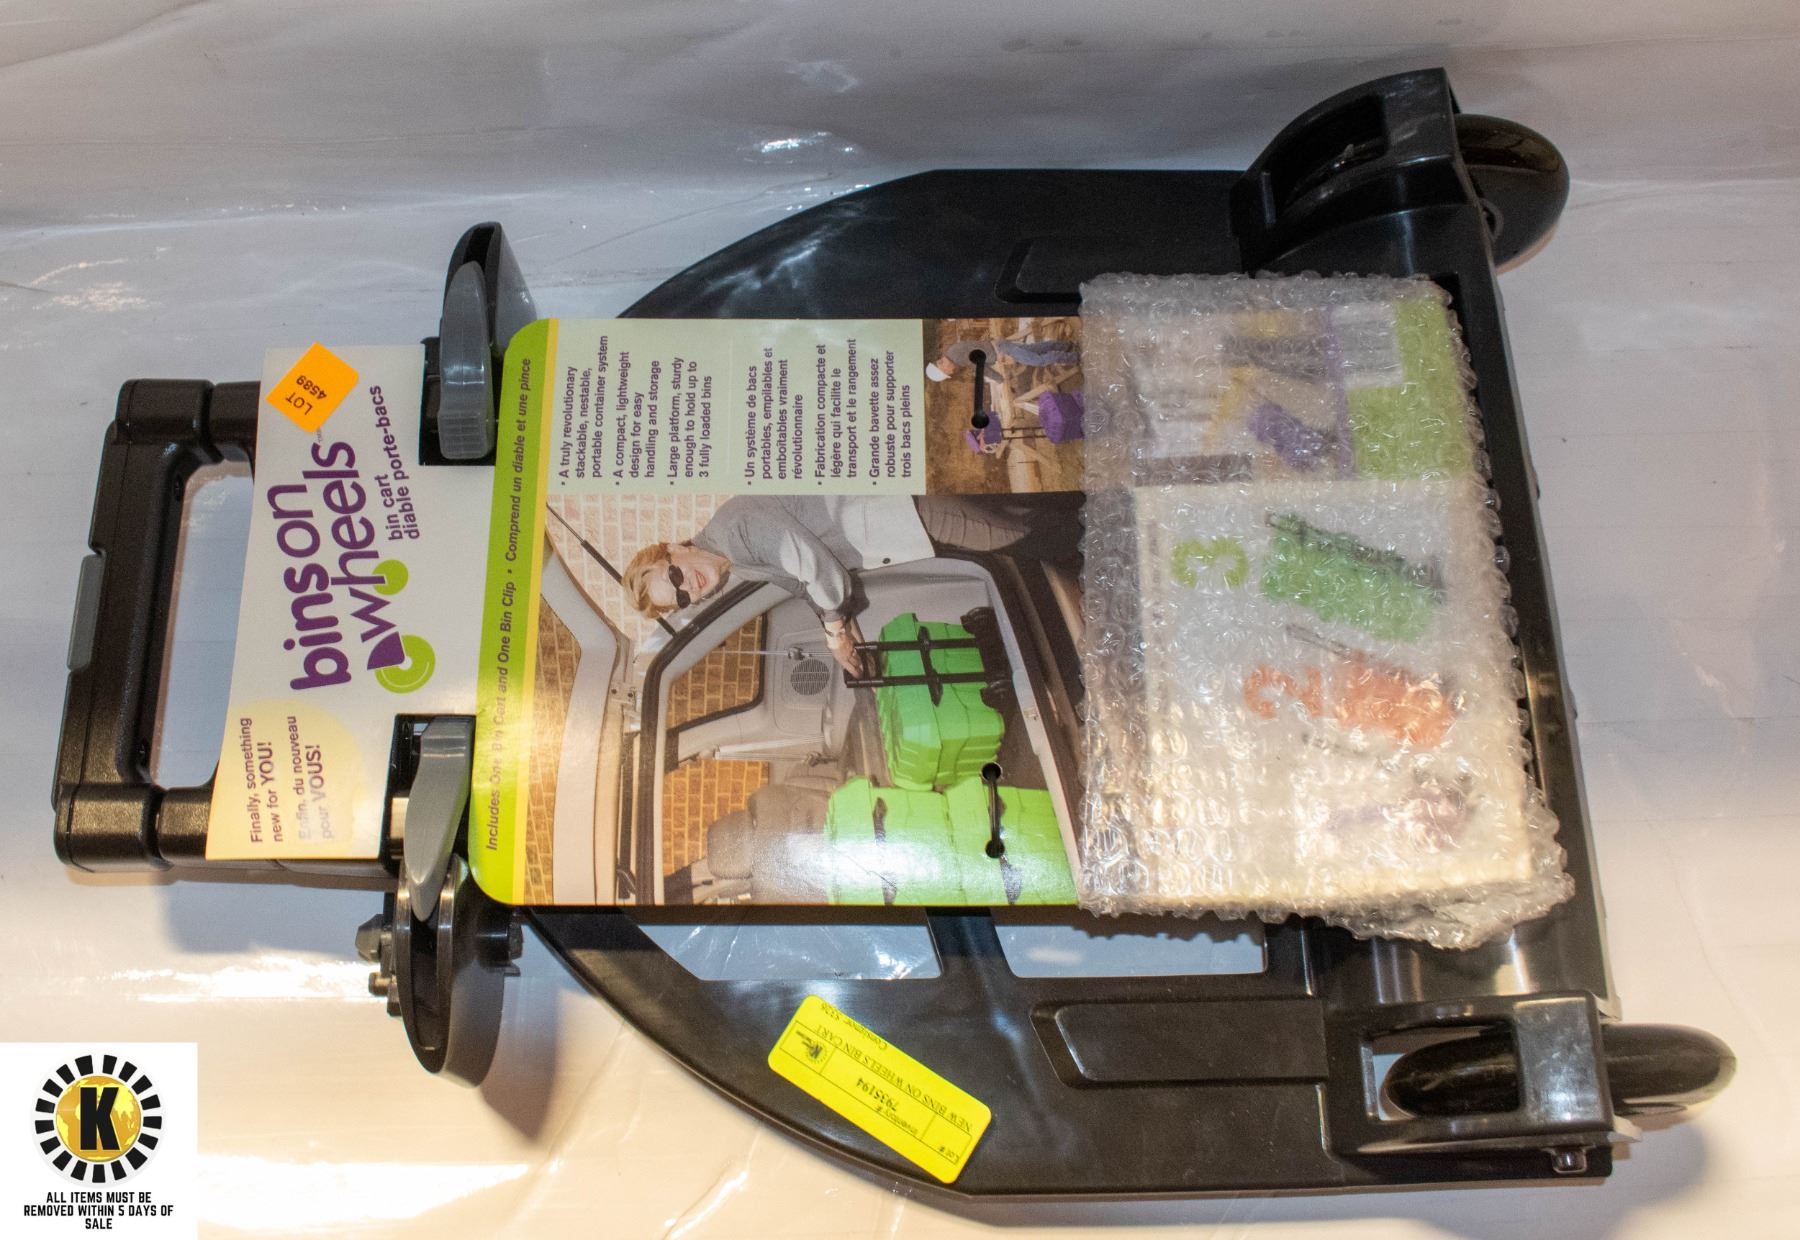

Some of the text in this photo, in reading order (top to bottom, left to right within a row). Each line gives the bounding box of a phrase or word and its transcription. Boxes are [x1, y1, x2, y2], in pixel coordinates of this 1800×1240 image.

[285, 392, 312, 415] LOT
[296, 376, 327, 399] 4589
[519, 359, 531, 391] pince
[701, 376, 712, 398] bins
[516, 420, 525, 431] et
[518, 395, 528, 416] une
[559, 367, 577, 478] A truly revolutionary
[575, 368, 591, 478] stackable, nestable,
[592, 336, 609, 478] portable container system
[613, 352, 631, 478] A compact, lightweight
[630, 392, 644, 478] design for easy
[645, 361, 661, 478] handling and storage
[667, 358, 684, 477] Large platform, sturdy
[684, 362, 699, 477] enough to hold up to
[700, 403, 711, 440] loaded
[745, 366, 757, 477] Un système de bacs
[761, 348, 773, 479] portables, empilables et
[776, 360, 787, 479] emboîtables vraiment
[815, 345, 827, 477] Fabrication compacte et
[830, 369, 843, 477] légère qui facilite le
[846, 339, 858, 477] transport et le rangement
[869, 358, 879, 477] Grande bavette assez
[885, 351, 897, 477] robuste pour supporter
[900, 385, 912, 477] trois bacs pleins
[369, 385, 420, 539] diable porte-bacs
[511, 436, 525, 472] diable
[699, 444, 711, 467] fully
[792, 395, 802, 479] révolutionnaire
[374, 474, 403, 540] bin cart
[513, 478, 522, 492] un
[303, 441, 397, 642] wheels
[505, 496, 520, 561] Comprend
[499, 612, 512, 632] Bin
[502, 582, 516, 607] Clip
[498, 637, 510, 662] One
[496, 668, 508, 692] and
[287, 716, 302, 773] nouveau
[305, 745, 325, 802] VOUS!
[240, 718, 262, 842] Finally, something
[257, 742, 283, 842] new for YOU!
[293, 779, 304, 795] du
[486, 791, 500, 850] Includes
[815, 1024, 844, 1047] CART
[843, 1043, 862, 1058] BIN
[855, 1077, 901, 1111] 7935194
[862, 1055, 905, 1086] WHEELS
[905, 1083, 922, 1097] ON
[922, 1095, 947, 1114] BINS
[945, 1110, 972, 1131] NEW
